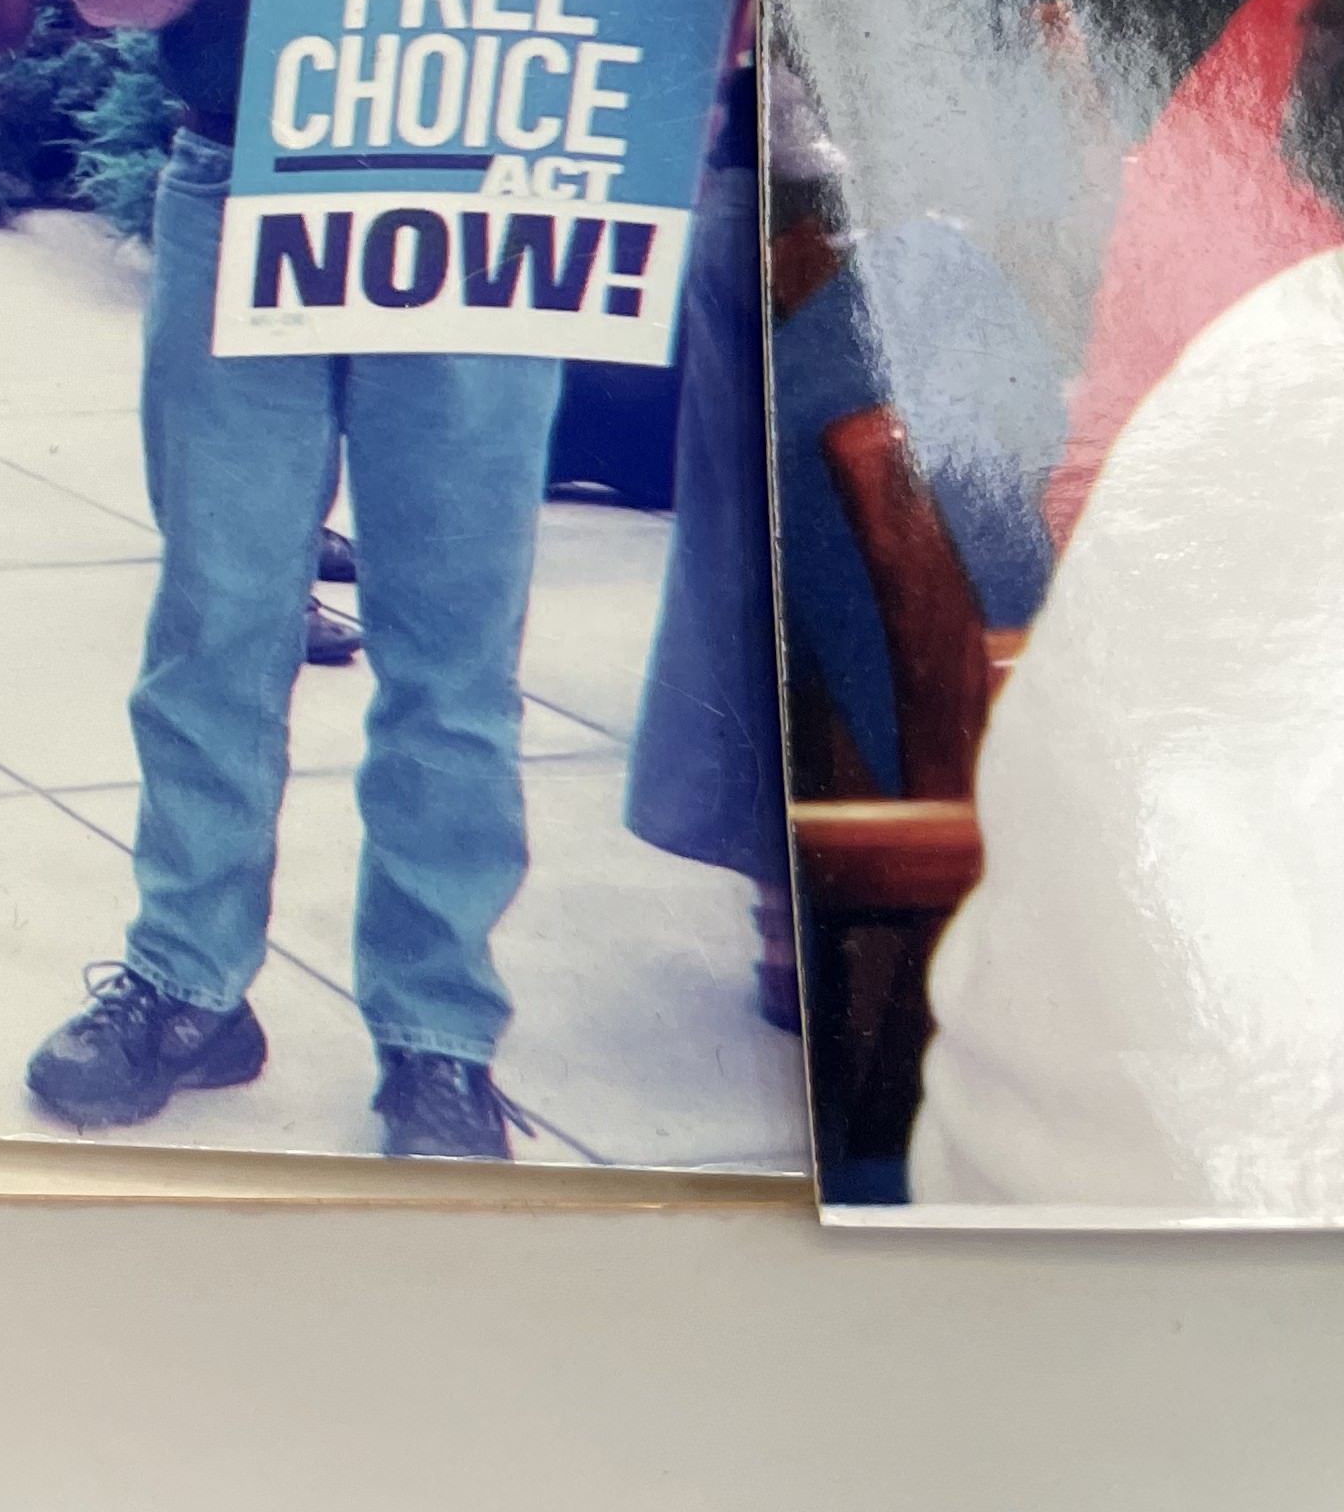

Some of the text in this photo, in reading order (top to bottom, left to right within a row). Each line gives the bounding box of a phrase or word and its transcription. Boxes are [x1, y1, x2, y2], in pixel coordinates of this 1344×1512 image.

[271, 34, 641, 156] CHOICE
[479, 154, 624, 203] ACT
[252, 207, 657, 318] NOW!
